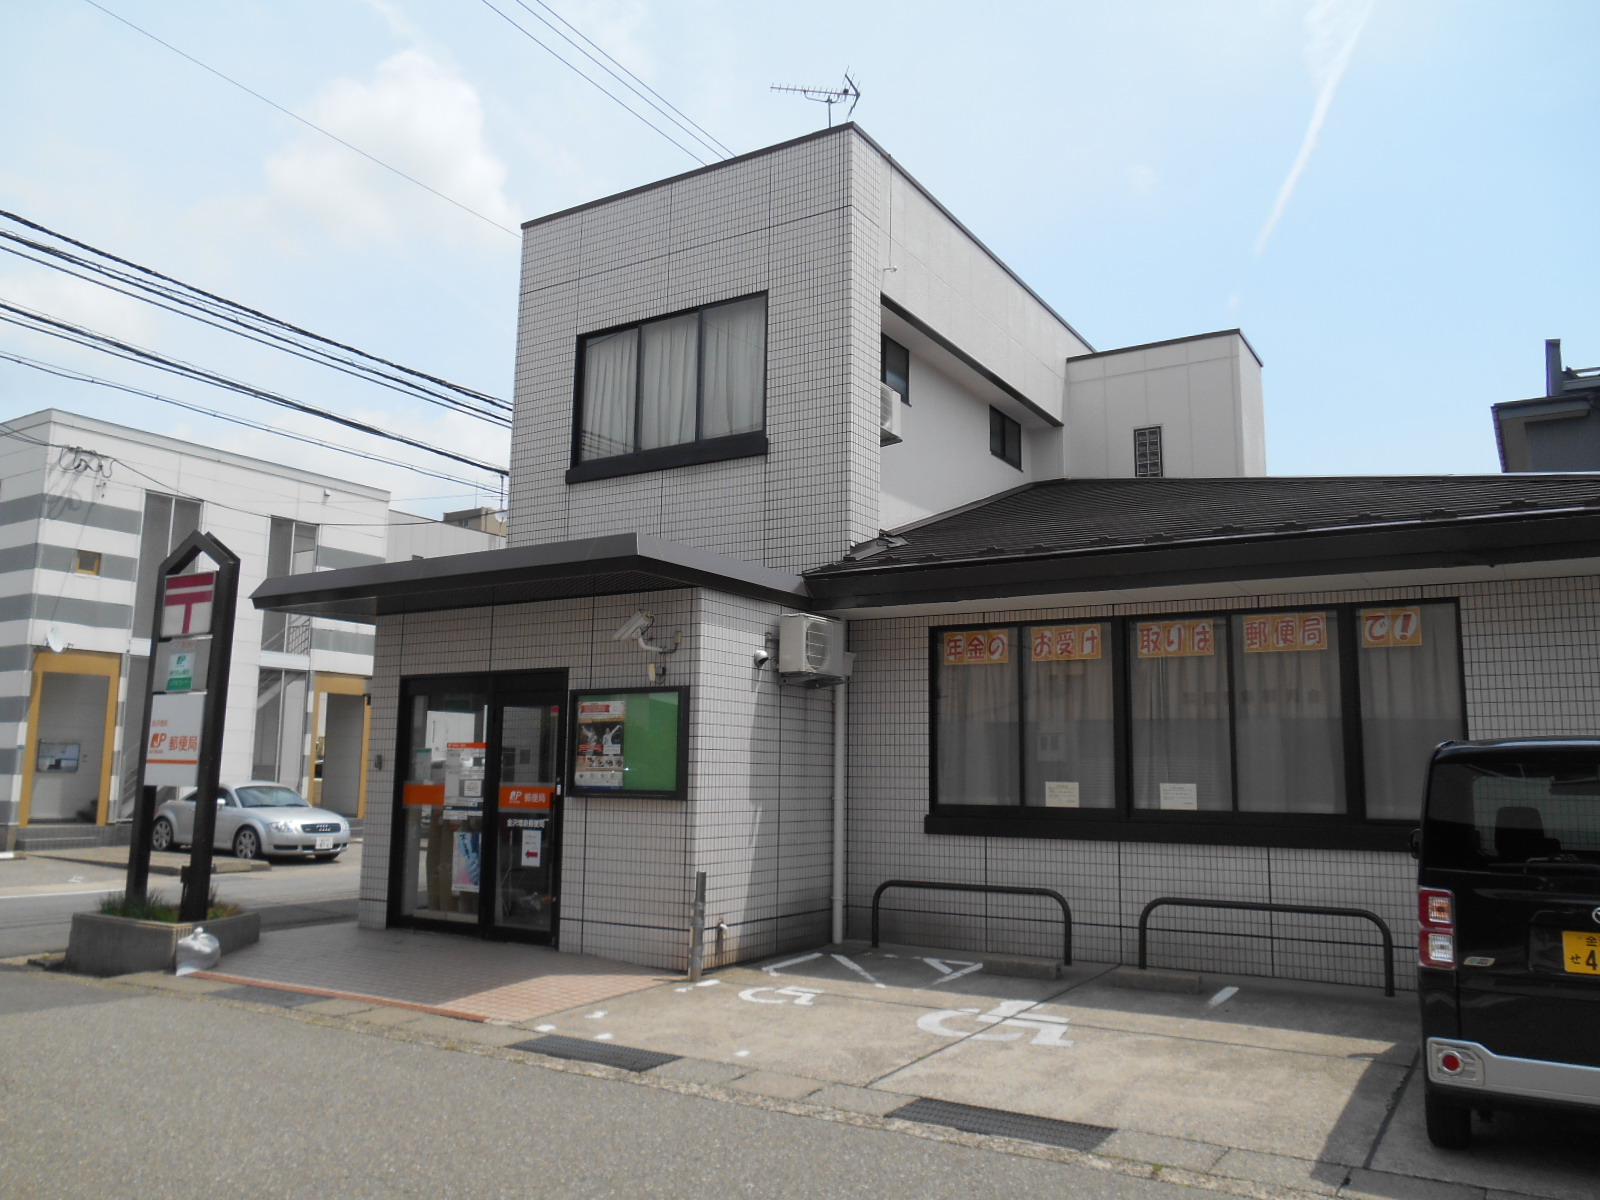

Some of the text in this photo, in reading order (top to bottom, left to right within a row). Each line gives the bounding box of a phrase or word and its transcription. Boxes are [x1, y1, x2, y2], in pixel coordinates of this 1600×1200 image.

[946, 635, 1006, 660] 年金の
[1033, 629, 1099, 657] お受け
[1138, 624, 1211, 653] 取りは
[1244, 616, 1322, 648] 郵便局
[169, 735, 198, 752] 郵便局
